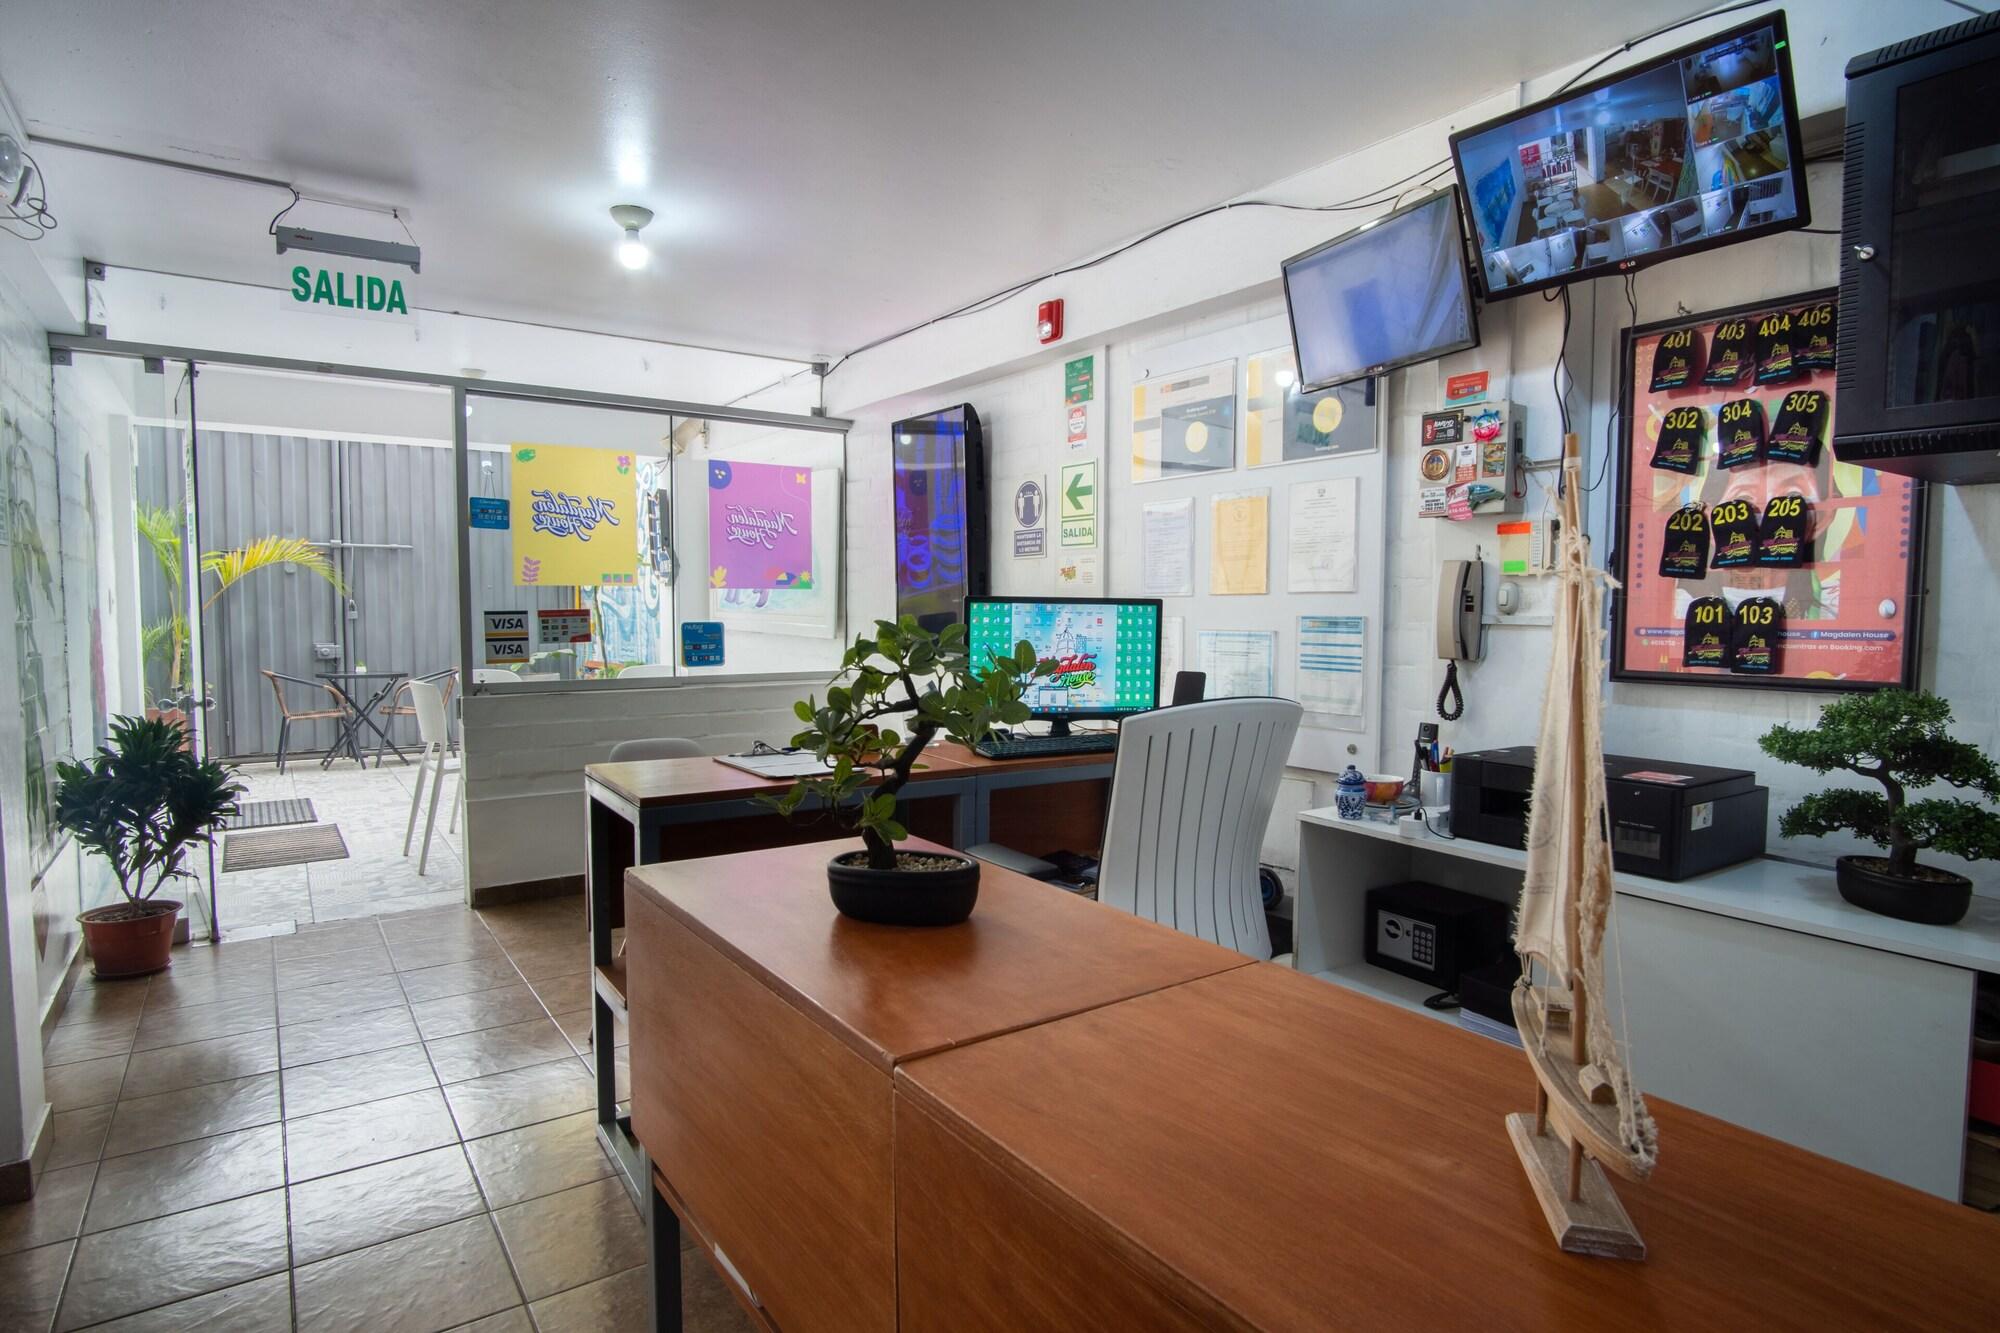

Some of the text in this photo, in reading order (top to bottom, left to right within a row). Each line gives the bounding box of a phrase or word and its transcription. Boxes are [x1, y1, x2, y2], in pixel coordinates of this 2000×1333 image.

[291, 265, 408, 315] SALIDA
[1759, 315, 1791, 337] 404
[1798, 306, 1831, 327] 405
[1664, 331, 1692, 349] 401
[1717, 323, 1745, 341] 403
[1723, 401, 1752, 423] 304
[1786, 394, 1819, 413] 305
[1665, 411, 1698, 429] 302
[1713, 503, 1749, 525] 203
[1768, 498, 1801, 517] 205
[1669, 513, 1703, 531] 202
[1063, 527, 1093, 538] SALIDA
[491, 618, 524, 629] VISA
[1695, 605, 1723, 624] 101
[1739, 605, 1773, 624] 103
[1820, 631, 1861, 640] Magdalen
[1862, 631, 1889, 639] House
[492, 644, 524, 655] VISA
